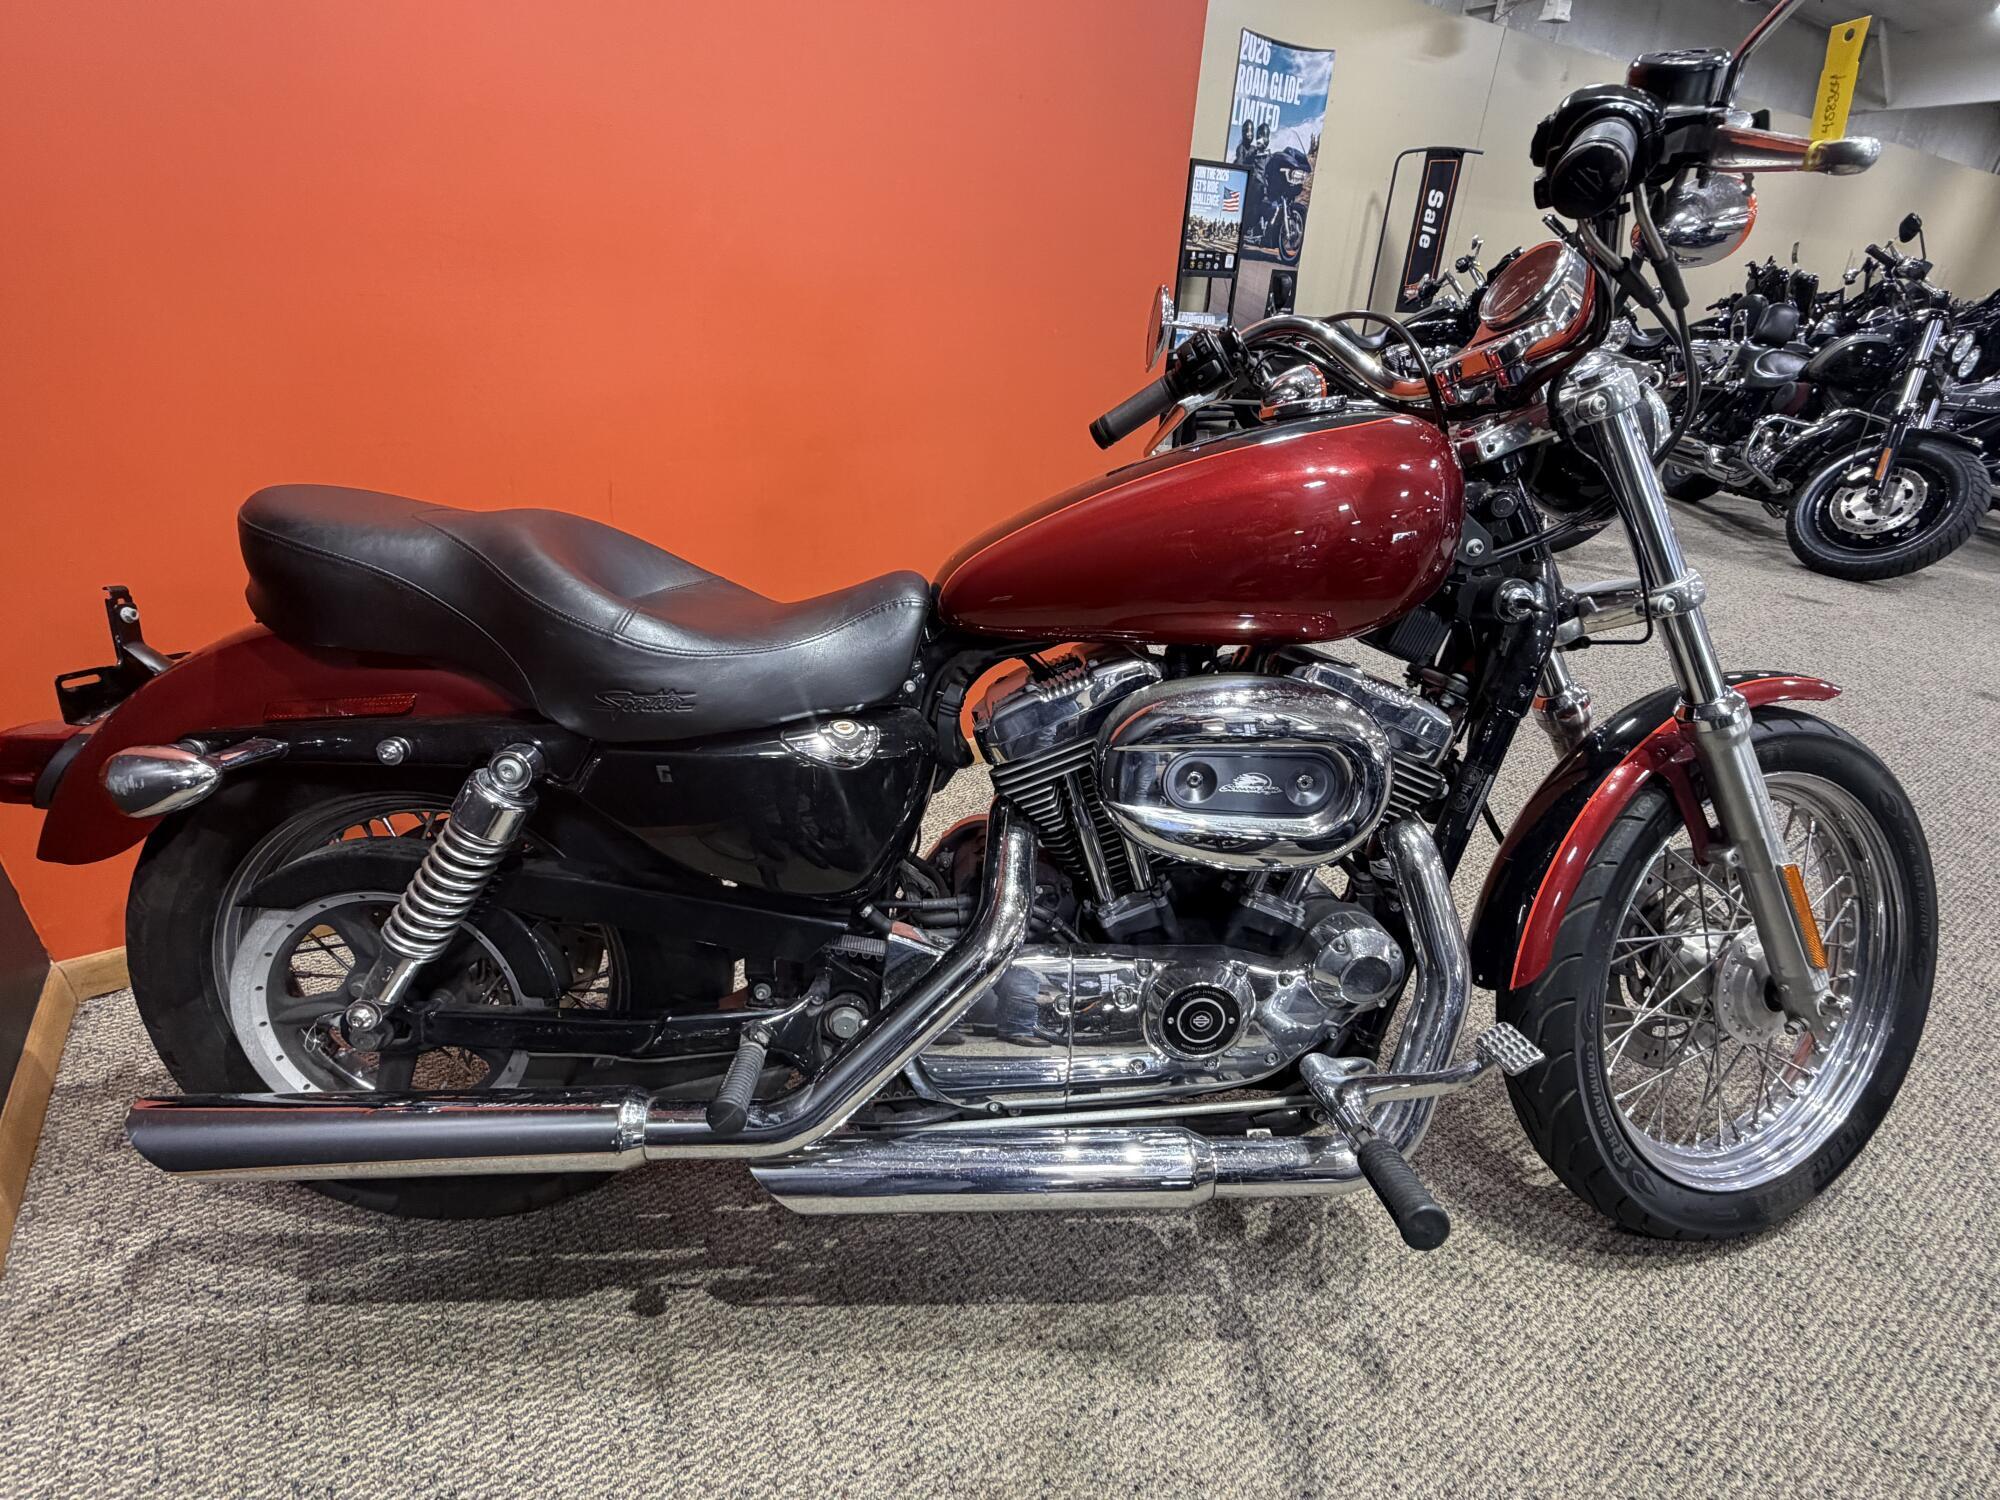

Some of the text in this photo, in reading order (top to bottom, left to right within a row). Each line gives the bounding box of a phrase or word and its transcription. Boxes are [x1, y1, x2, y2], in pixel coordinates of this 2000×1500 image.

[1240, 30, 1272, 66] 2026
[1235, 63, 1304, 106] ROAD GLIDE
[1231, 95, 1281, 133] LIMITED
[1418, 188, 1445, 249] Sale
[1586, 1041, 1619, 1148] COMMANDER
